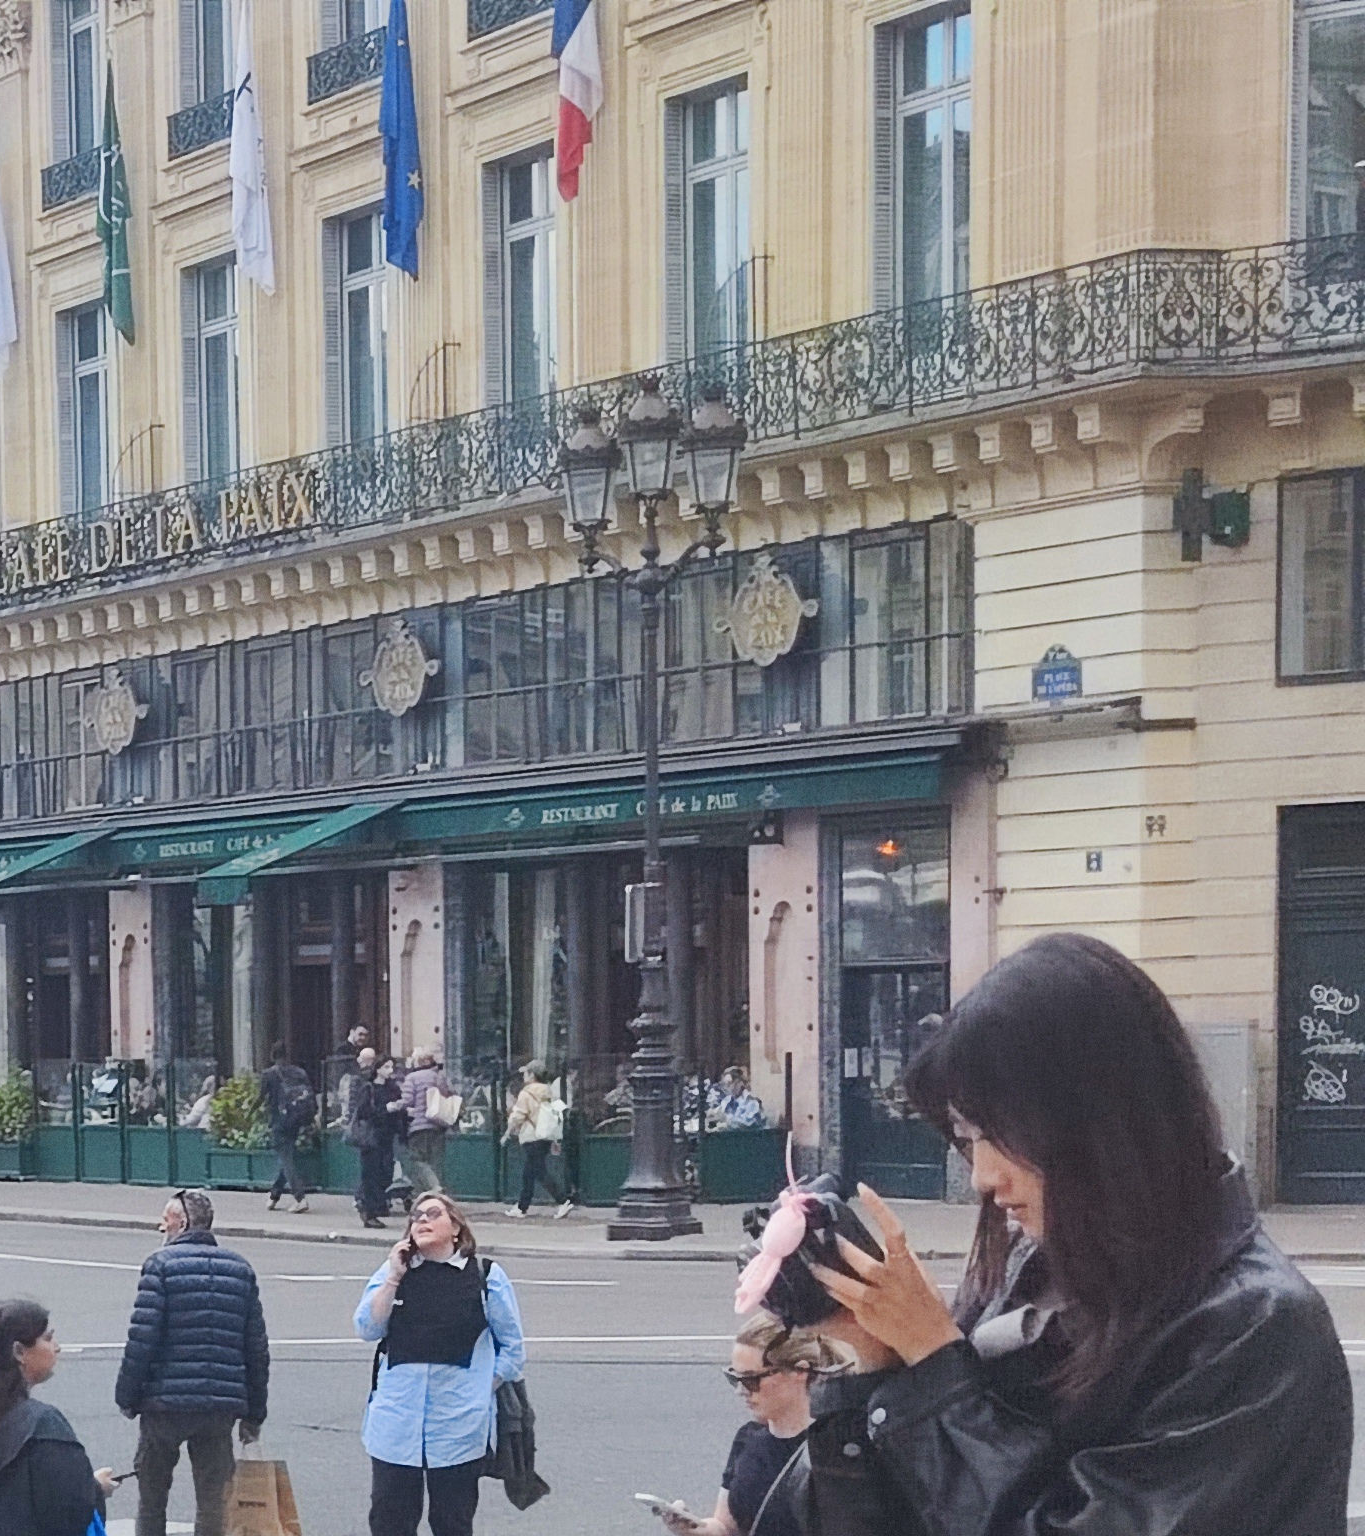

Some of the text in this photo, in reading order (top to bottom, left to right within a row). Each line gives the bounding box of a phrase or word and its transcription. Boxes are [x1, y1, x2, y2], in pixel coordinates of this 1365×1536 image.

[88, 513, 136, 575] DE
[154, 498, 203, 558] LA
[219, 472, 316, 544] PAIX
[540, 803, 619, 824] RESTAURANT
